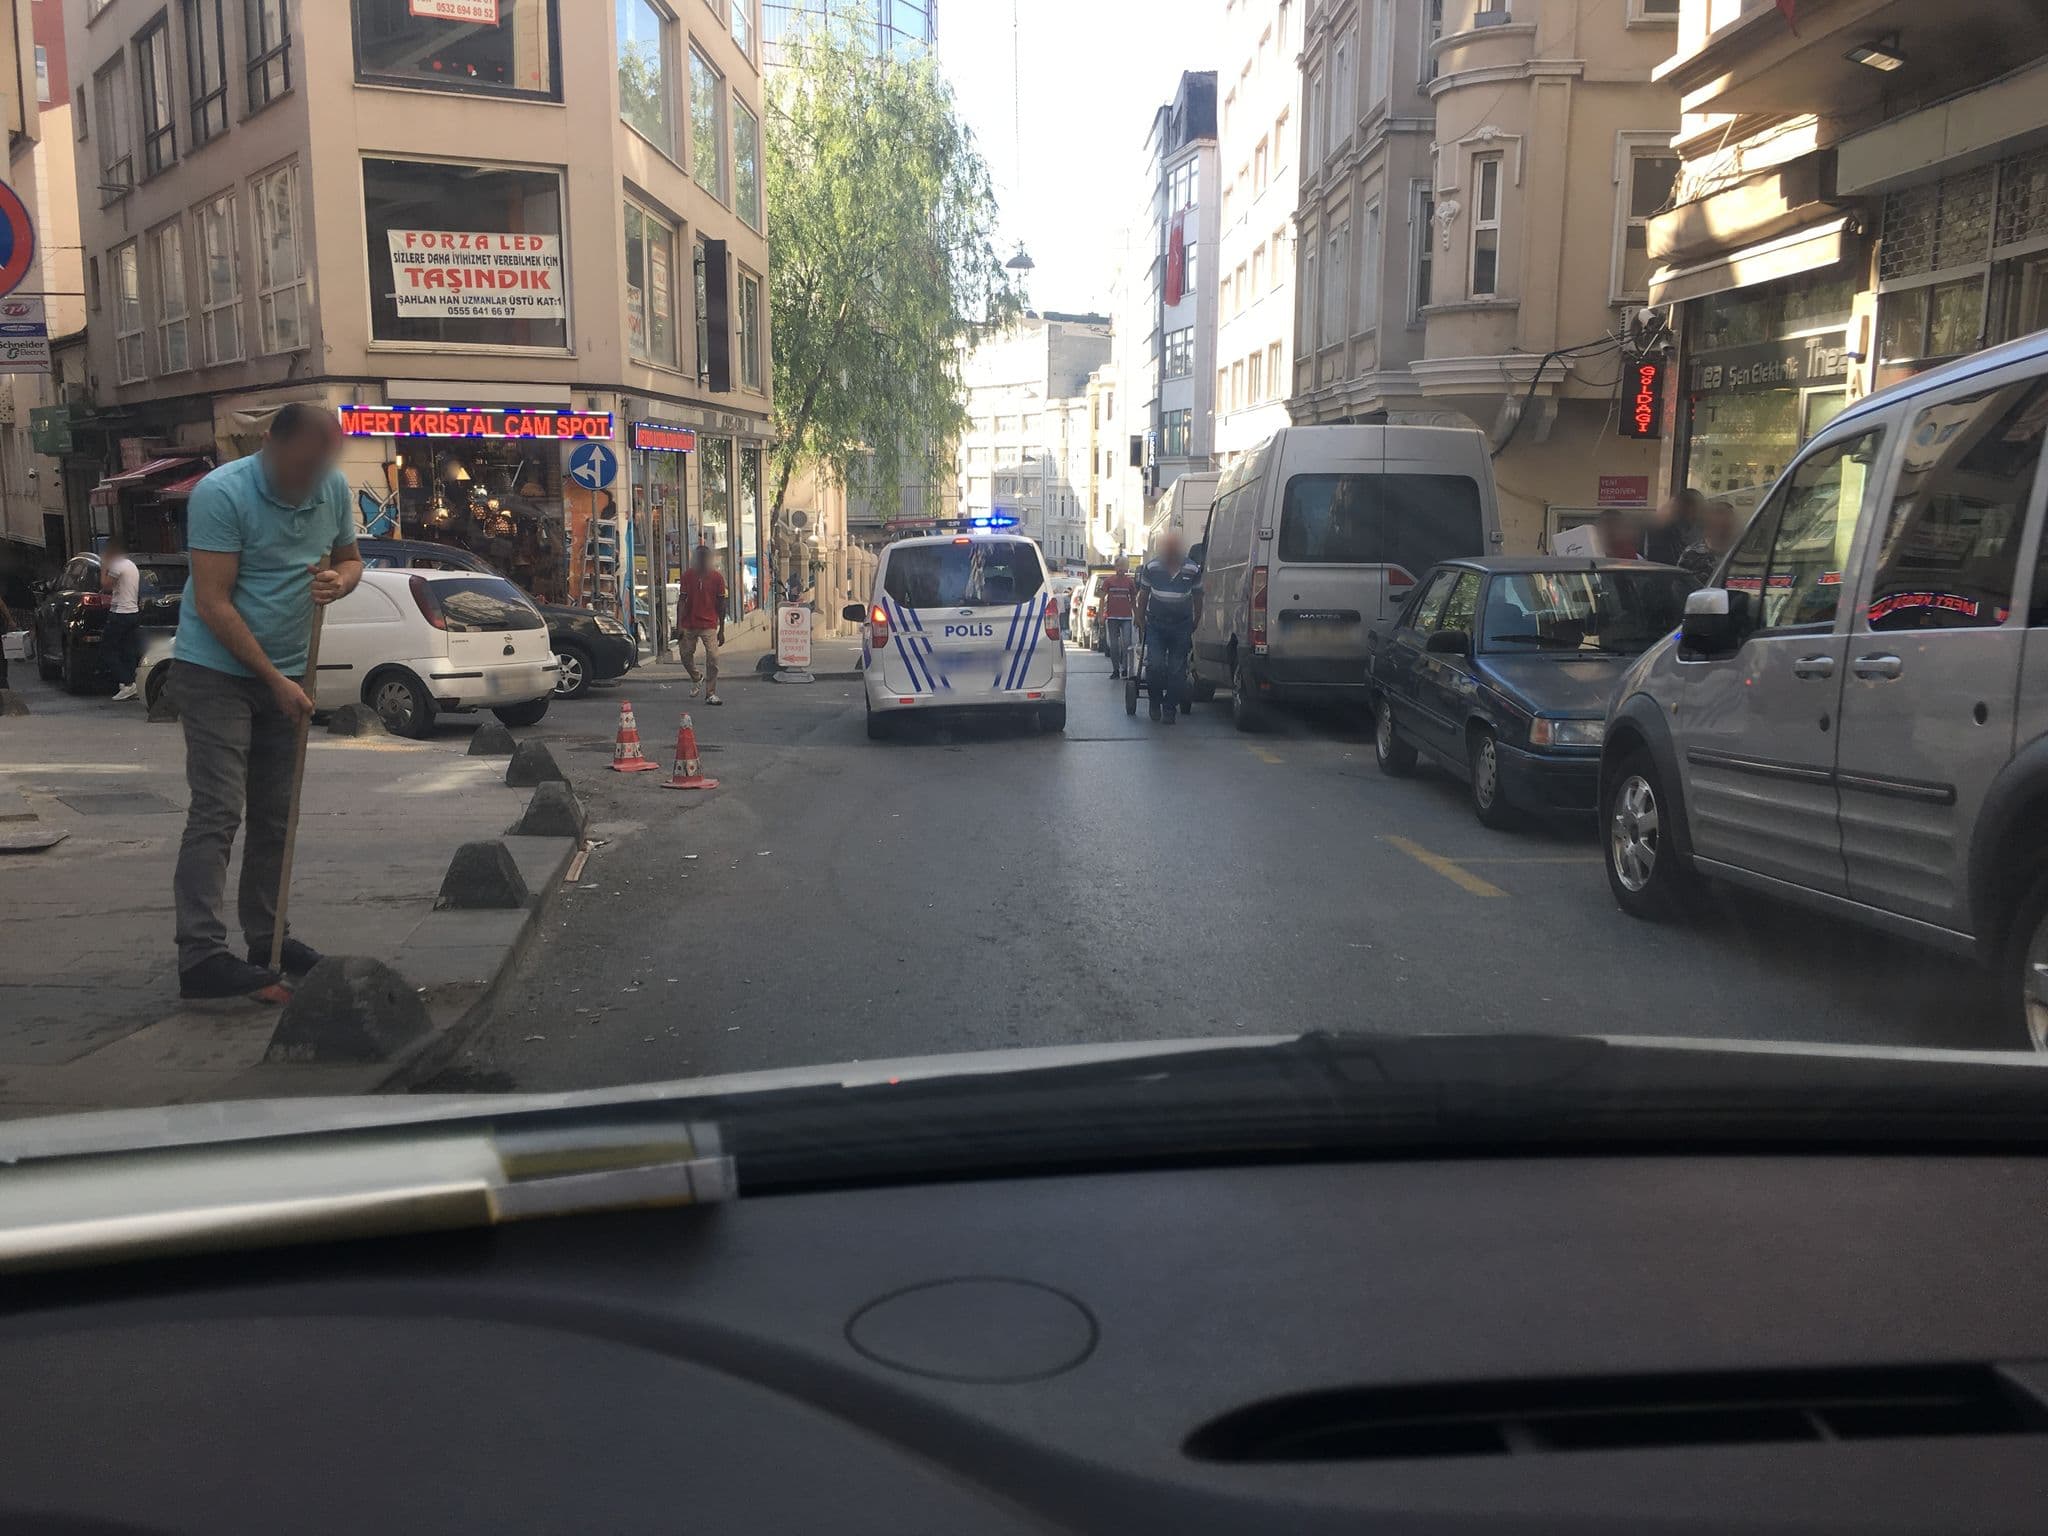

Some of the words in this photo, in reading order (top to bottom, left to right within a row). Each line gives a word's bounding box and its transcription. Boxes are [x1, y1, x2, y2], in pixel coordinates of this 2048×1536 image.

[436, 2, 456, 14] 0532
[457, 5, 472, 16] 694
[473, 7, 483, 17] 80
[484, 9, 494, 18] 52
[405, 232, 489, 250] FORZA
[500, 235, 544, 251] LED
[393, 251, 425, 264] SİZLERE
[428, 252, 450, 265] DAHA
[494, 254, 541, 267] VEREBİLMEK
[542, 254, 558, 268] İÇİN
[404, 267, 551, 294] TAŞINDIK
[398, 295, 437, 306] ŞAHLAN
[439, 296, 460, 305] HAN
[462, 296, 507, 306] UZMANLAR
[509, 295, 534, 306] ÜSTÜ
[536, 297, 562, 306] KAT:1
[447, 307, 470, 316] 0555
[472, 307, 489, 316] 641
[491, 307, 503, 316] 66
[504, 308, 516, 316] 97
[0, 340, 45, 349] Schneider
[342, 412, 403, 433] MERT
[409, 410, 500, 435] KRİSTAL
[504, 416, 551, 436] CAM
[557, 417, 609, 437] SPOT
[945, 622, 993, 637] POLİS
